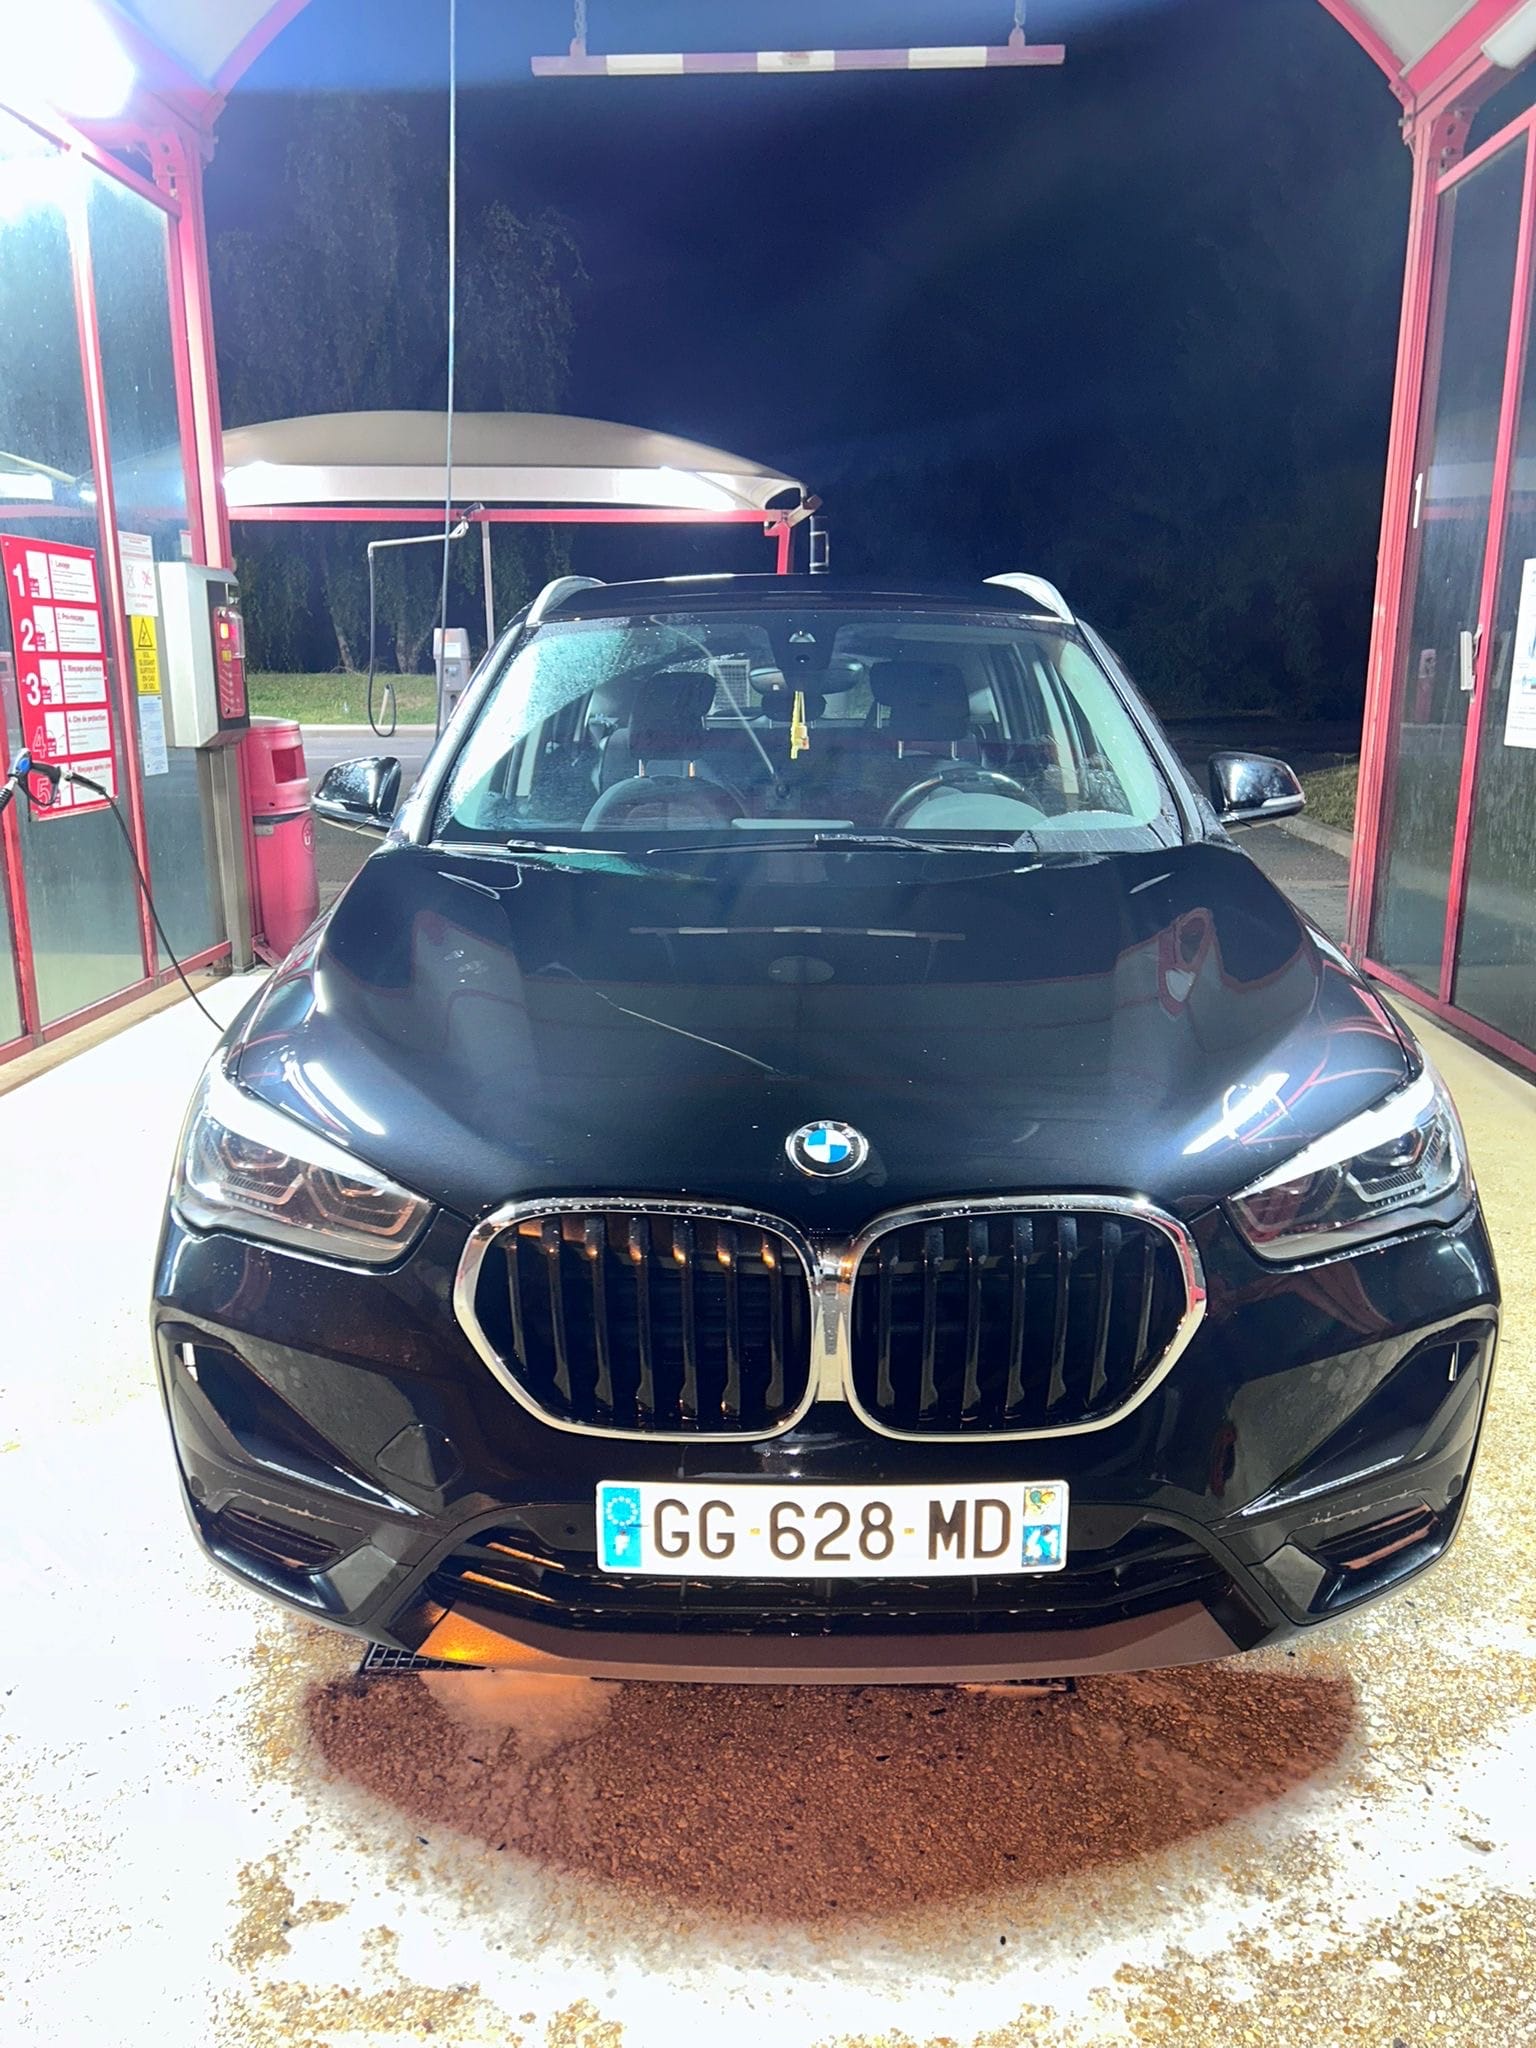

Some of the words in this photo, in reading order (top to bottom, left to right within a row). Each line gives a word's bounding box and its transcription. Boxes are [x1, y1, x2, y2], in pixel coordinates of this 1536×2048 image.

[12, 562, 25, 598] 1
[20, 618, 36, 652] 2
[26, 672, 41, 706] 3
[32, 726, 47, 759] 4
[653, 1498, 736, 1560] GG
[768, 1500, 895, 1562] 628
[927, 1498, 1012, 1560] MD
